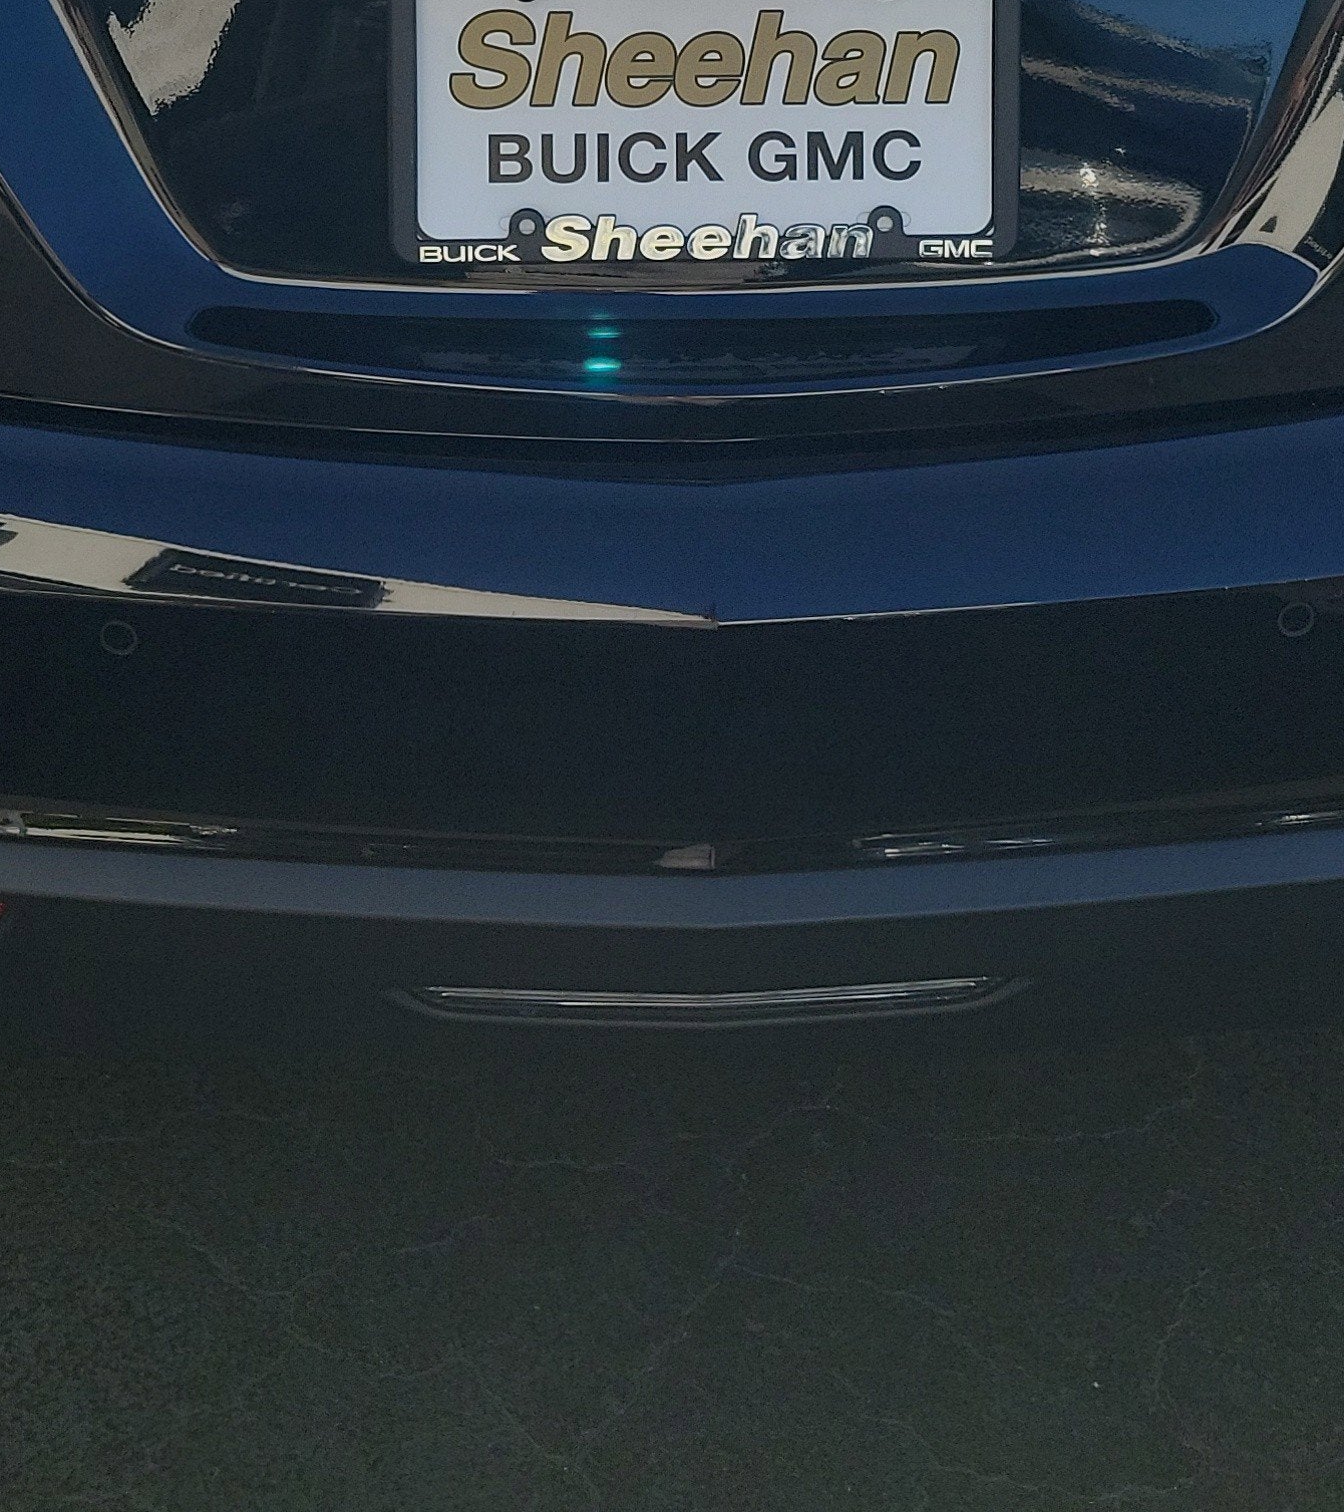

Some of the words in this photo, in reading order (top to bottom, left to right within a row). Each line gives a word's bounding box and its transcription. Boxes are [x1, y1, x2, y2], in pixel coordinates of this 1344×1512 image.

[448, 8, 962, 110] Sheehan
[487, 131, 725, 184] BUICK
[748, 129, 922, 182] GMC
[419, 239, 521, 263] BUICK
[919, 239, 994, 259] GMC
[540, 213, 873, 262] Sheehan
